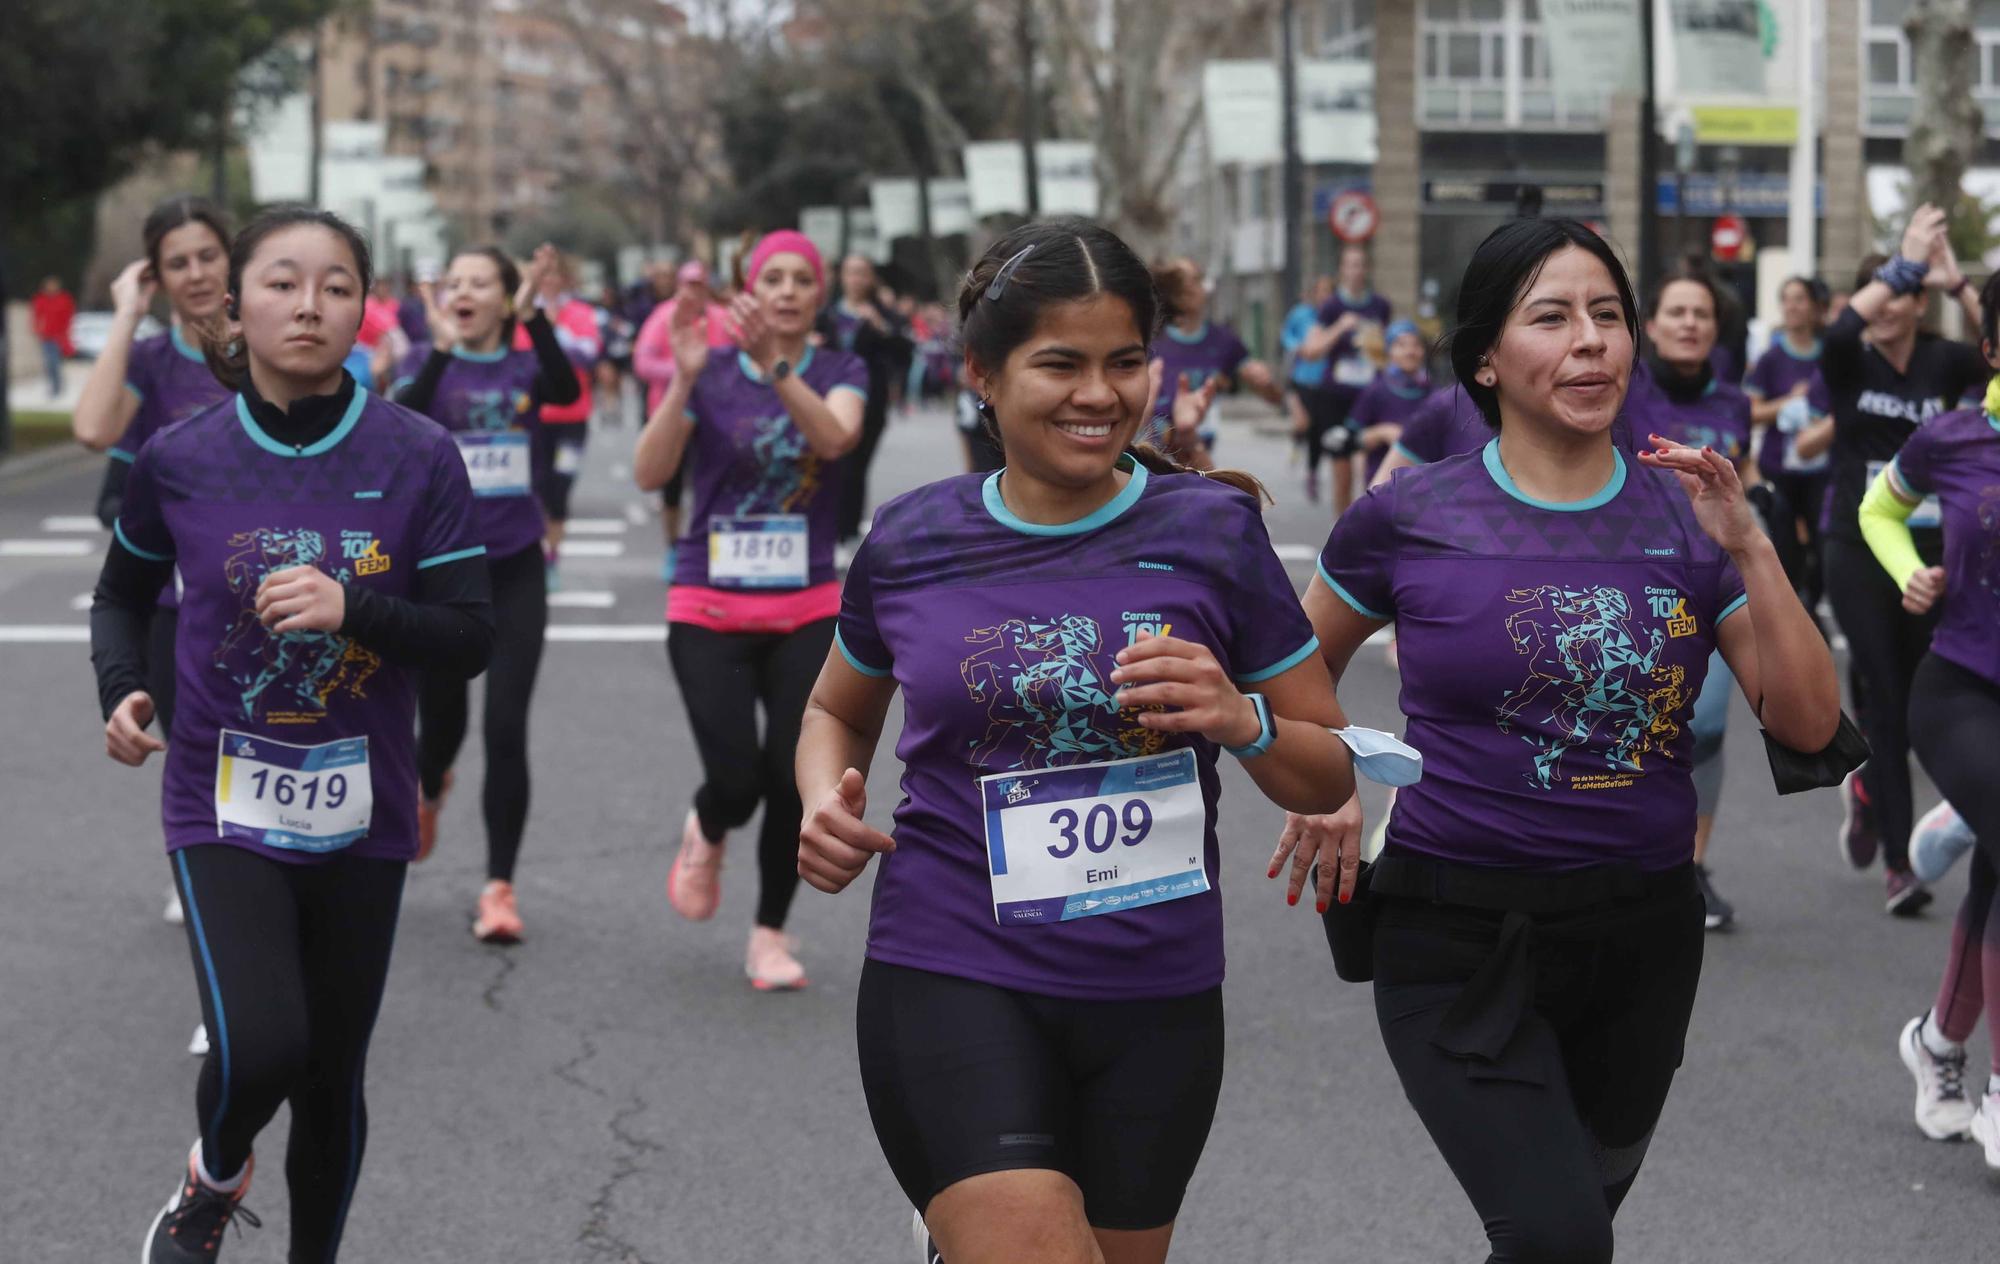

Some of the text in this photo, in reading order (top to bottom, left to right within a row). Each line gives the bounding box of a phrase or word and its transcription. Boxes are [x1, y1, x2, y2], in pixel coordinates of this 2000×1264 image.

[341, 539, 381, 559] 10K
[733, 537, 794, 559] 1810
[358, 558, 389, 574] FEM
[1121, 611, 1161, 621] Carrera
[1647, 596, 1687, 619] 10K
[1670, 618, 1696, 636] FEM
[251, 768, 348, 811] 1619
[1008, 789, 1030, 803] FEM
[1046, 798, 1153, 859] 309
[1188, 856, 1197, 865] M
[1086, 865, 1119, 884] Emi
